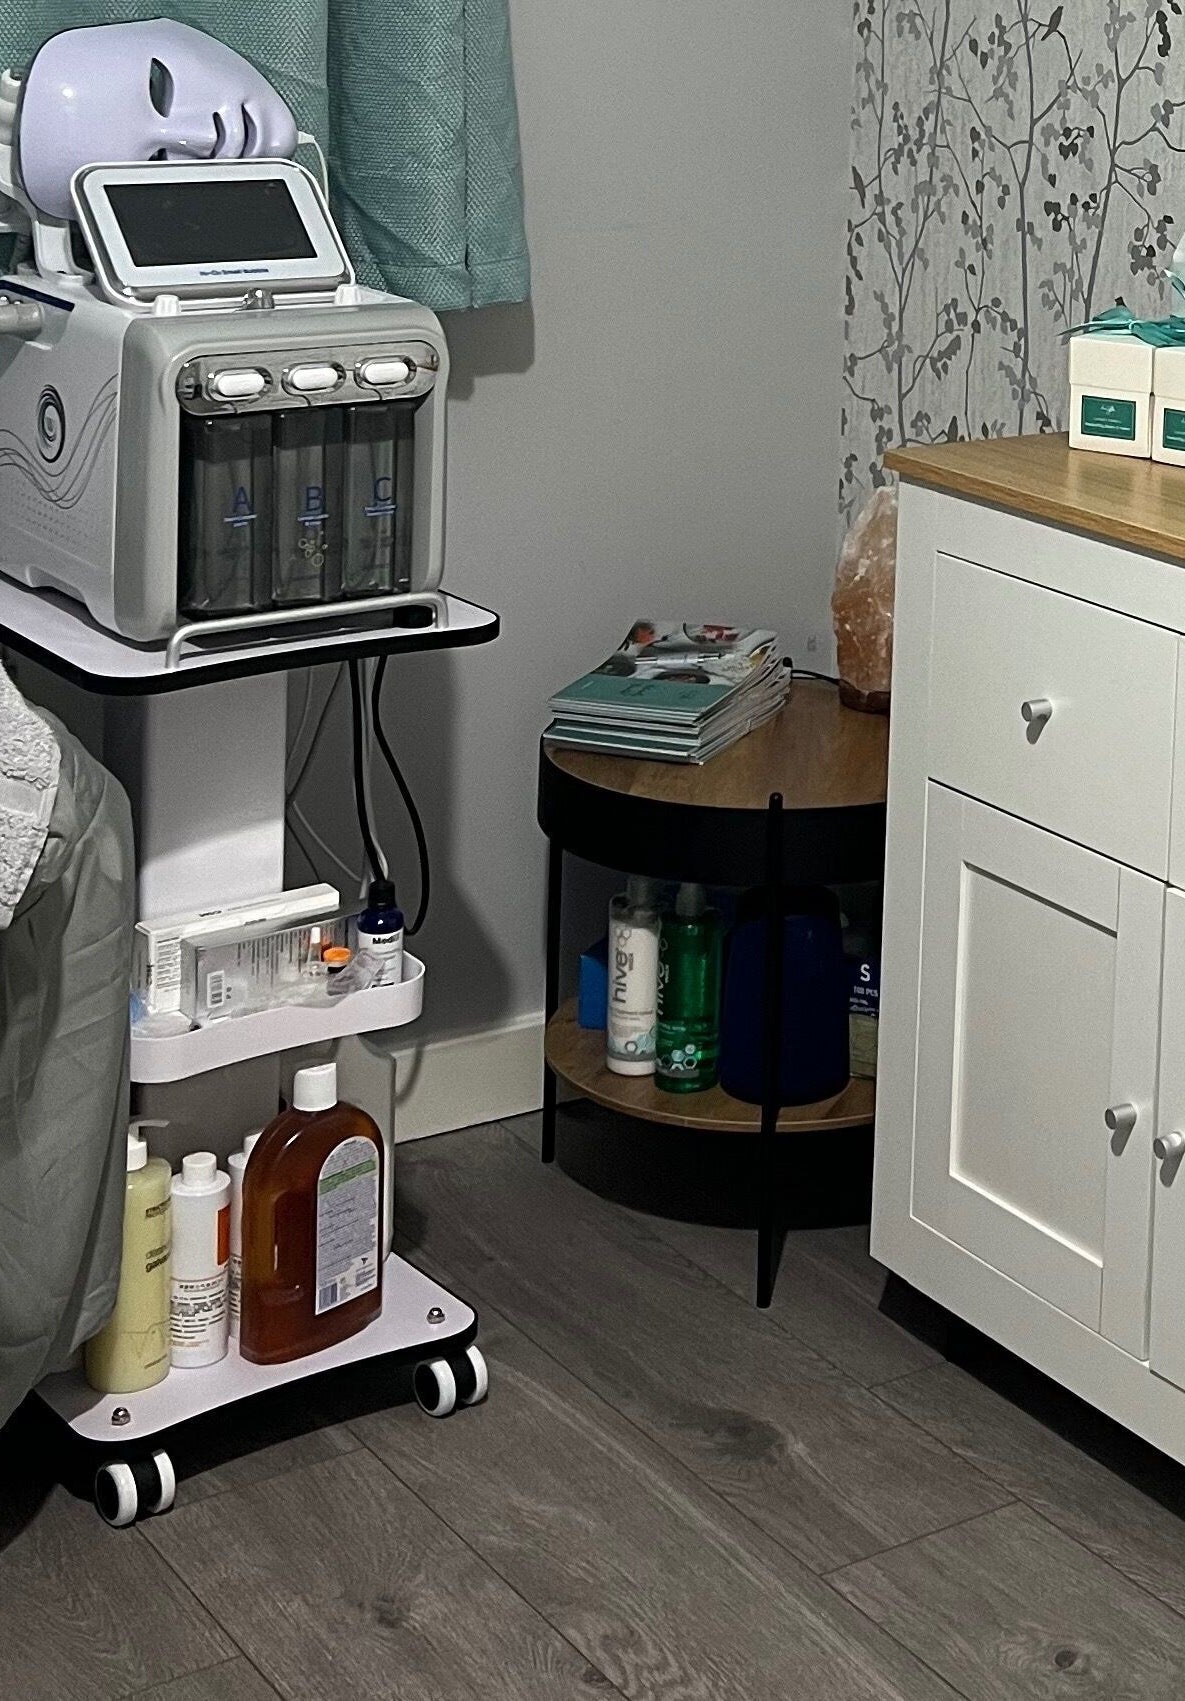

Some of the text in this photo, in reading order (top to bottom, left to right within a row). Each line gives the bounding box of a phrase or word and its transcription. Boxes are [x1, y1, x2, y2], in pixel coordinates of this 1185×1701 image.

[233, 486, 252, 513] A
[306, 486, 323, 511] B
[373, 476, 392, 502] C
[612, 949, 629, 1004] hive
[860, 963, 871, 982] S
